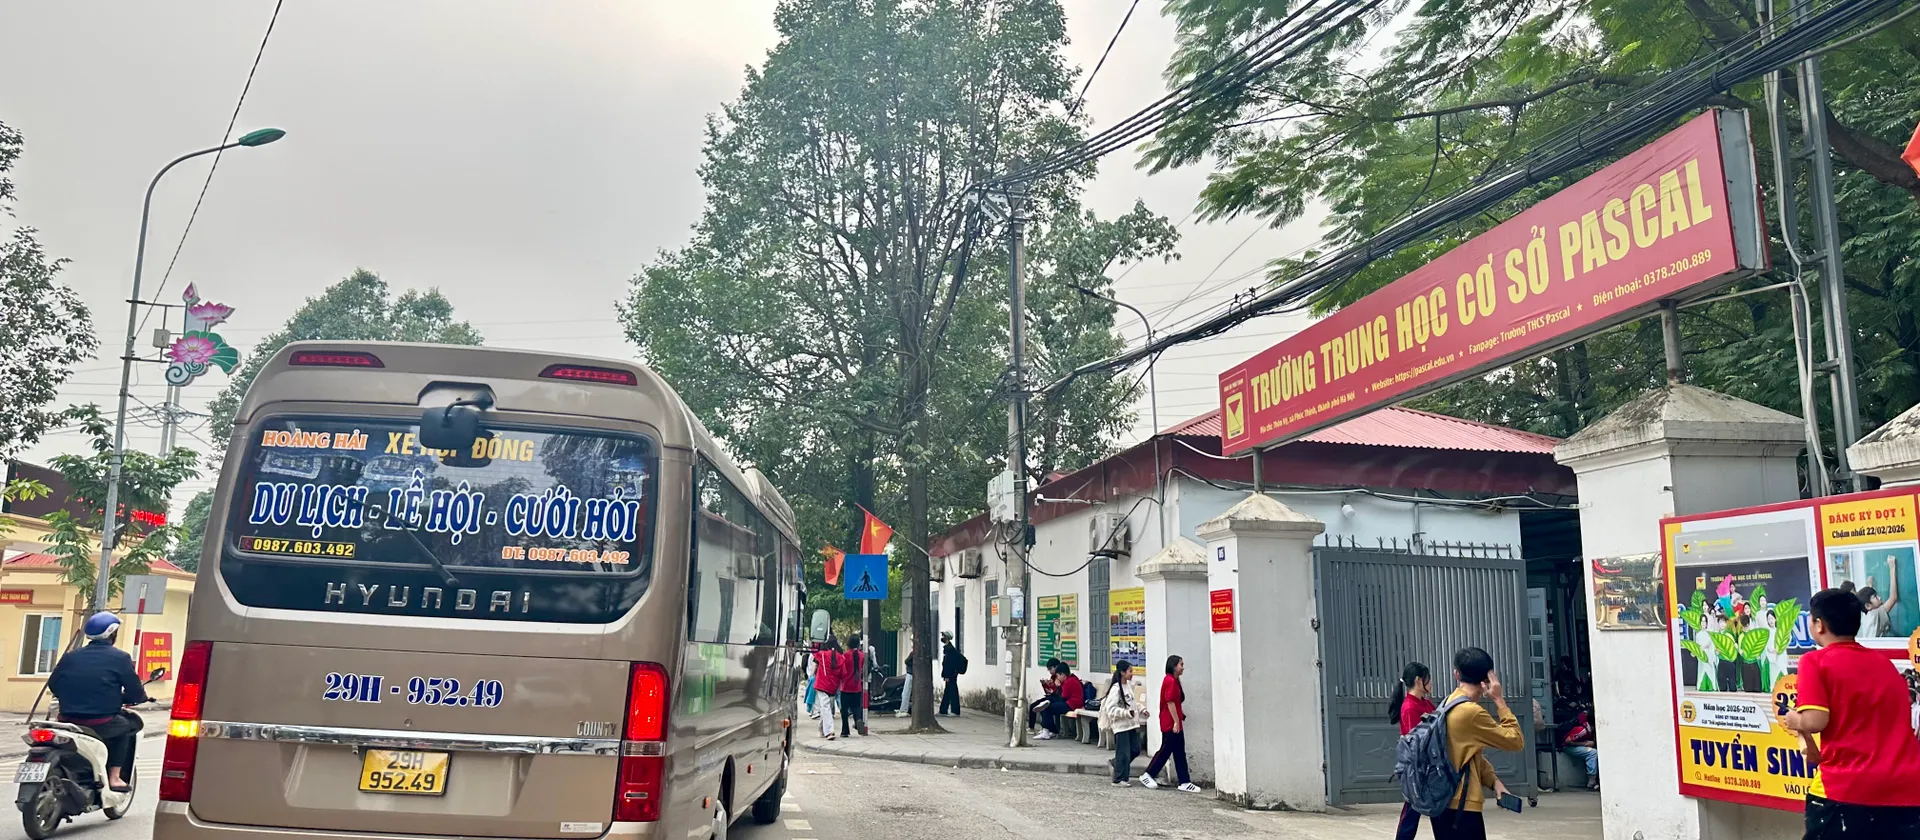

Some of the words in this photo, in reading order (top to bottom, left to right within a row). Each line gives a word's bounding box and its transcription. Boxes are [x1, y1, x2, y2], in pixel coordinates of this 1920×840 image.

[1251, 350, 1316, 413] TRƯỜNG
[1320, 315, 1390, 384] TRUNG
[1395, 286, 1448, 352] HỌC
[1456, 252, 1496, 325] CƠ
[1504, 225, 1549, 303] SỞ
[1559, 159, 1712, 282] PASCAL
[1317, 401, 1330, 412] thành
[1330, 396, 1340, 409] phố
[1339, 395, 1346, 404] Hà
[1371, 376, 1395, 391] Website:
[1394, 352, 1455, 383] https://pascal.edu.vn
[1468, 336, 1500, 354] Fanpage:
[1500, 324, 1526, 343] Trường
[1526, 316, 1545, 332] THCS
[1545, 305, 1571, 325] Pascal
[1592, 289, 1613, 306] Điện
[1614, 277, 1642, 297] thoại:
[1643, 248, 1712, 286] 0378.200.889
[261, 428, 331, 449] HOÀNG
[332, 428, 368, 450] HẢI
[384, 431, 416, 455] XE
[471, 431, 535, 462] ĐỒNG
[249, 482, 297, 525] DU
[296, 484, 368, 538] LỊCH
[425, 478, 485, 545] HỘI
[505, 484, 581, 539] CƯỚI
[581, 485, 640, 542] HỎI
[1828, 512, 1856, 524] ĐĂNG
[1859, 509, 1872, 521] KÝ
[1875, 507, 1896, 521] ĐỢT
[1901, 507, 1905, 517] 1
[1851, 526, 1865, 537] nhất
[1866, 524, 1905, 536] 22/02/2026
[253, 538, 355, 556] 0987.603.492
[502, 547, 525, 561] ĐT:
[528, 547, 630, 564] 0987.603.492
[324, 582, 531, 613] HYUNDAI
[1212, 606, 1232, 616] PASCAL
[323, 672, 384, 704] 29H
[407, 676, 504, 709] 952.49
[1684, 710, 1692, 719] 17
[1703, 703, 1715, 711] Năm
[1726, 705, 1756, 714] 2026-2027
[577, 720, 617, 737] COUNTY
[387, 751, 425, 770] 29H
[1690, 733, 1758, 772] TUYỂN
[369, 771, 436, 791] 952.49
[1703, 773, 1721, 784] Hotline
[1724, 776, 1761, 789] 0378.200.889
[1784, 781, 1800, 795] VÀO
